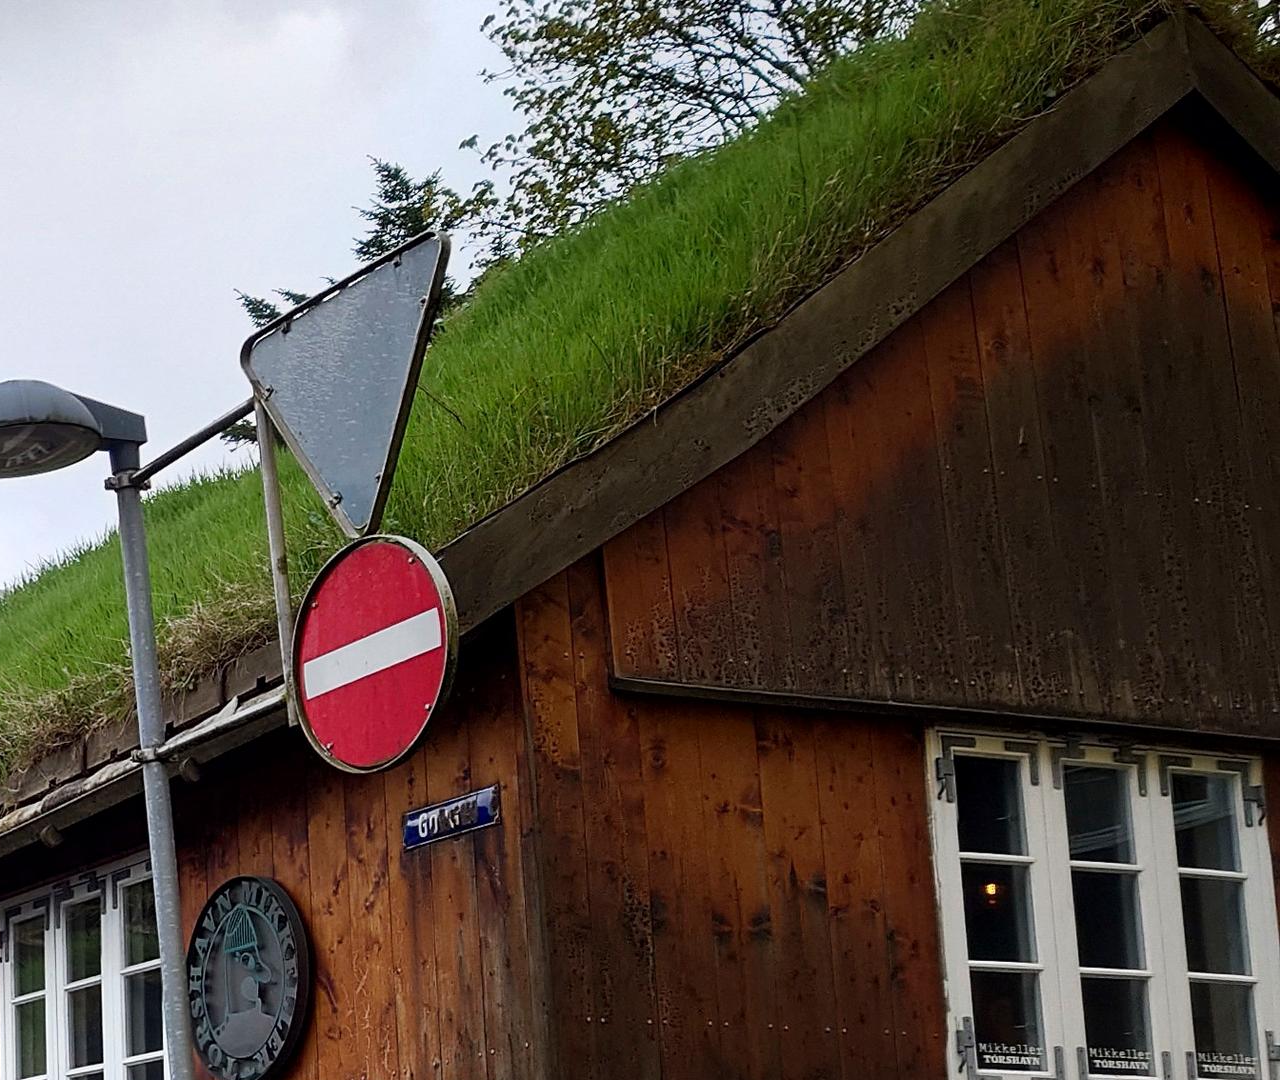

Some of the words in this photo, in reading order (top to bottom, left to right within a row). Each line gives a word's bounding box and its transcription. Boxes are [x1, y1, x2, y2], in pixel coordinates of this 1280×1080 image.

[978, 1043, 1043, 1055] Mikkeller
[1089, 1047, 1152, 1059] Mikkeller
[1198, 1052, 1257, 1064] Mikkeller
